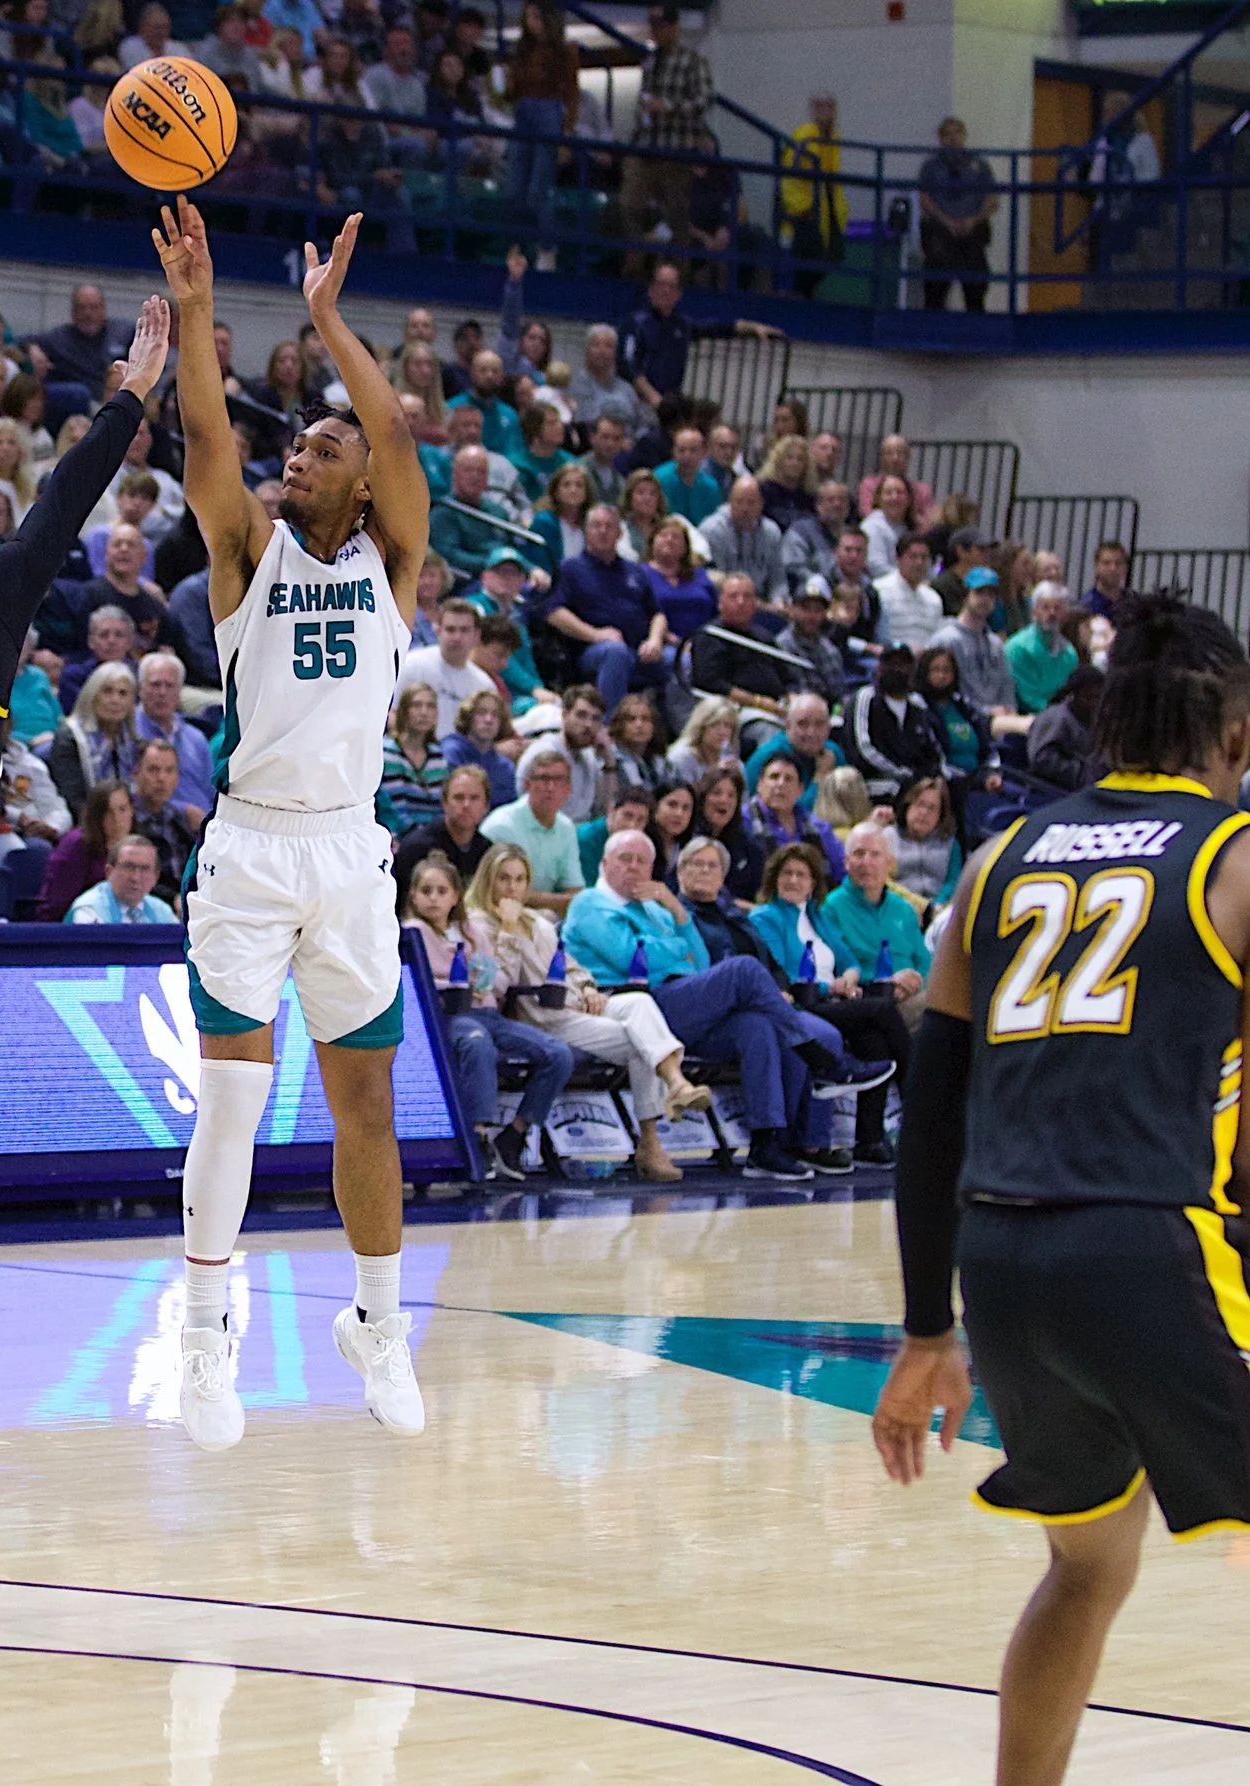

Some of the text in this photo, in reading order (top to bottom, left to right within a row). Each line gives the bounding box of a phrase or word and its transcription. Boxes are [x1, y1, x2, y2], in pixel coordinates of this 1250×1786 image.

[124, 90, 174, 140] NCAA
[144, 62, 207, 127] Wilson
[292, 620, 357, 680] 55
[1022, 820, 1184, 863] RUSSELL
[986, 866, 1155, 1045] 22
